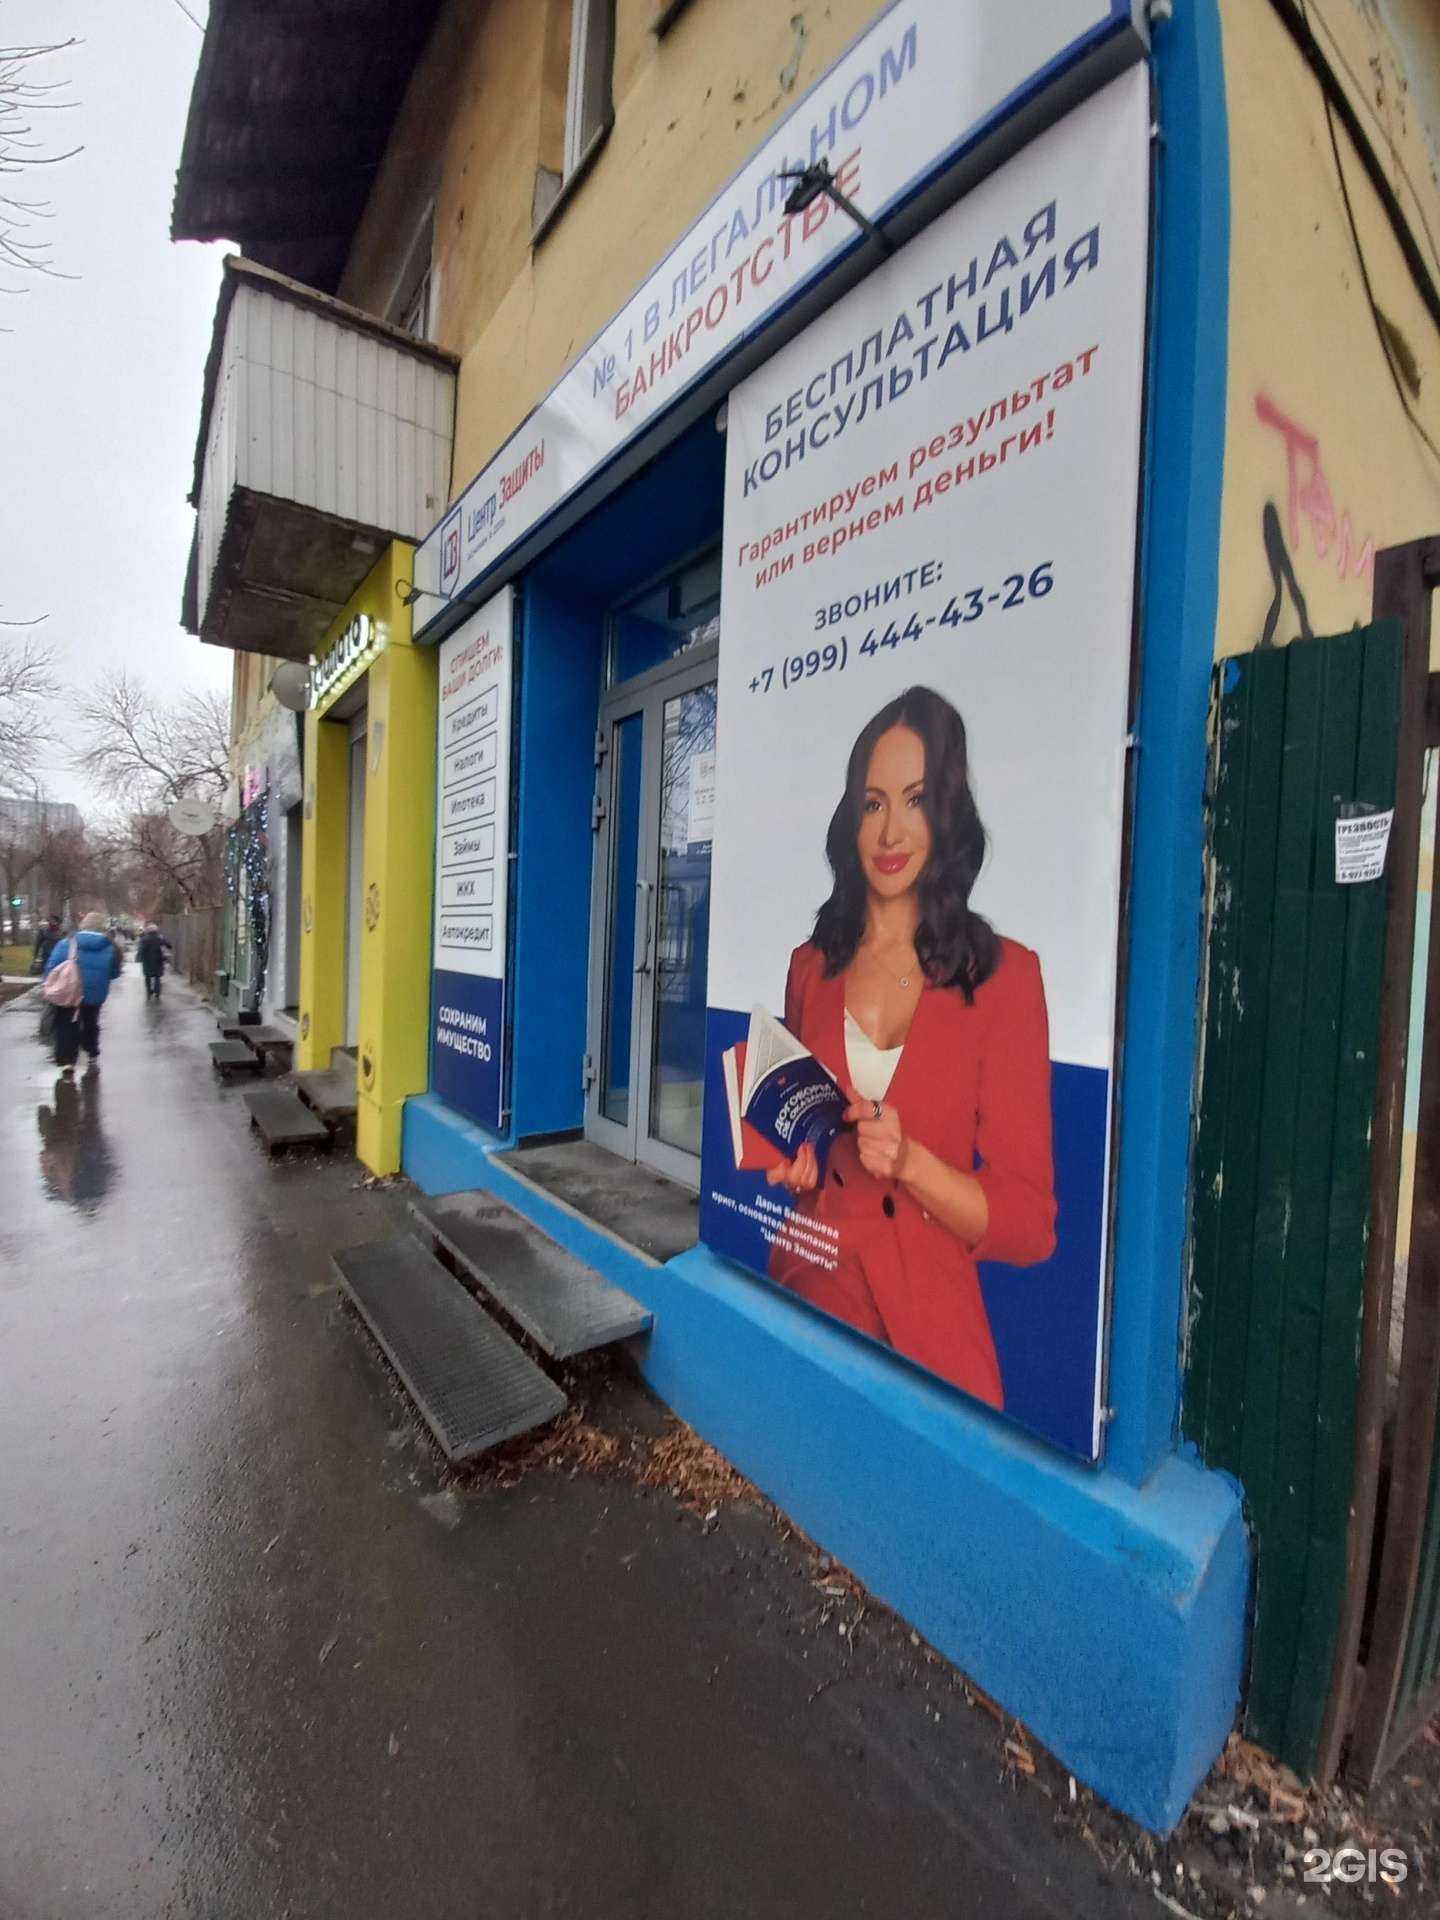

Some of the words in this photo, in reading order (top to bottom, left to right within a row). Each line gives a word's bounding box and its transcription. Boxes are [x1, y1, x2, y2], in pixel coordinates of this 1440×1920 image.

[615, 144, 862, 421] БАНКРОТСТВЕ
[764, 199, 1057, 443] БЕСПЛАТНАЯ
[624, 328, 633, 361] 1
[643, 301, 660, 345] В
[743, 222, 1100, 497] КОНСУЛЬТАЦИЯ
[468, 493, 497, 543] Центр
[499, 438, 545, 510] Защиты
[738, 461, 899, 567] Гарантируем
[908, 344, 1100, 479] результат
[755, 552, 794, 590] или
[802, 495, 904, 567] вернем
[912, 408, 1056, 513] деньги!
[748, 666, 775, 694] +7
[781, 635, 848, 689] (999)
[858, 560, 1055, 658] 444-43-26
[813, 559, 944, 631] ЗВОНИТЕ:
[451, 793, 486, 815] Ипотека
[436, 1027, 492, 1063] ИМУЩЕСТВО
[439, 1005, 488, 1037] СОХРАНИМ
[738, 1203, 788, 1234] основатель
[788, 1225, 839, 1256] компании
[755, 1193, 783, 1217] Дарья
